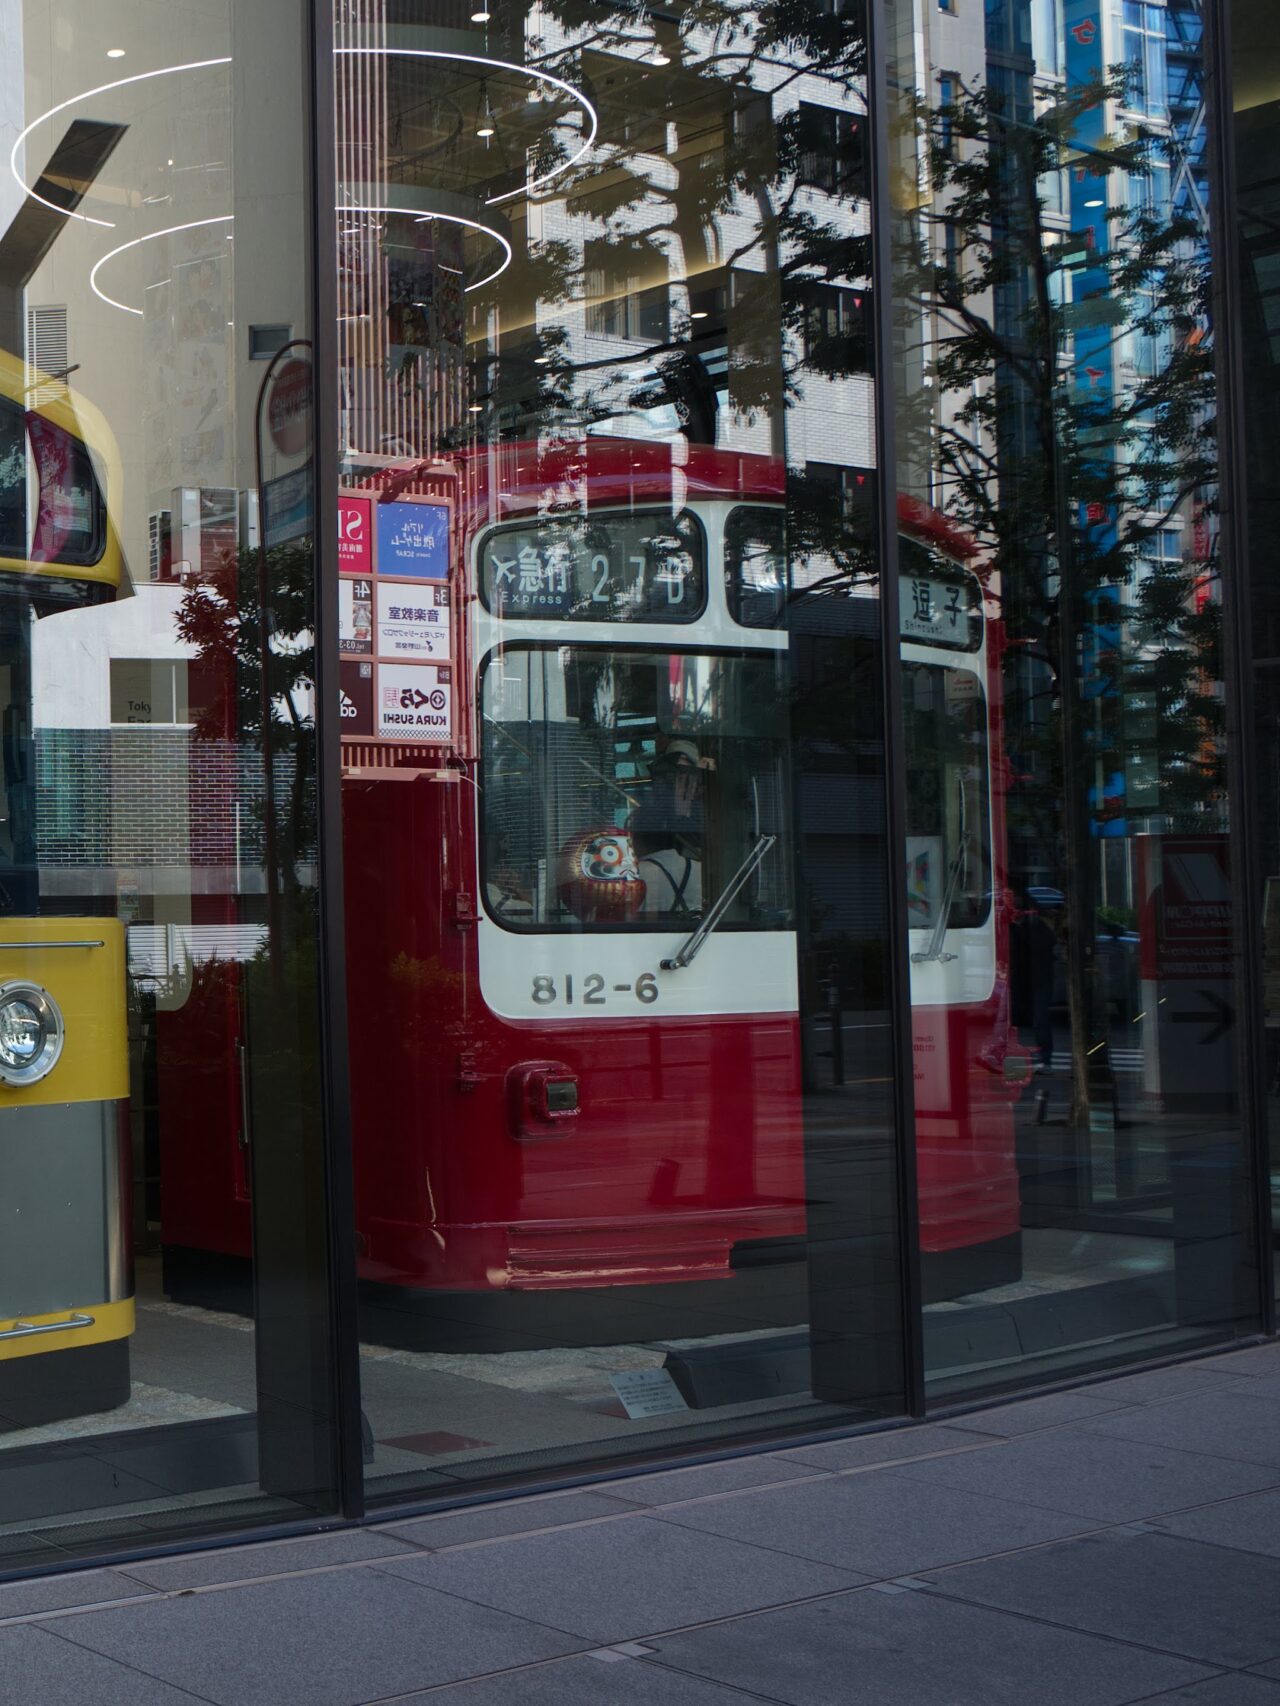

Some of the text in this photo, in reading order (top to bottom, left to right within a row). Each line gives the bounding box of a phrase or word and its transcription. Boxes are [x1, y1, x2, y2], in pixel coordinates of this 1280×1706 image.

[517, 546, 568, 594] 急行
[502, 591, 563, 605] Express
[531, 972, 659, 1005] 812-6
